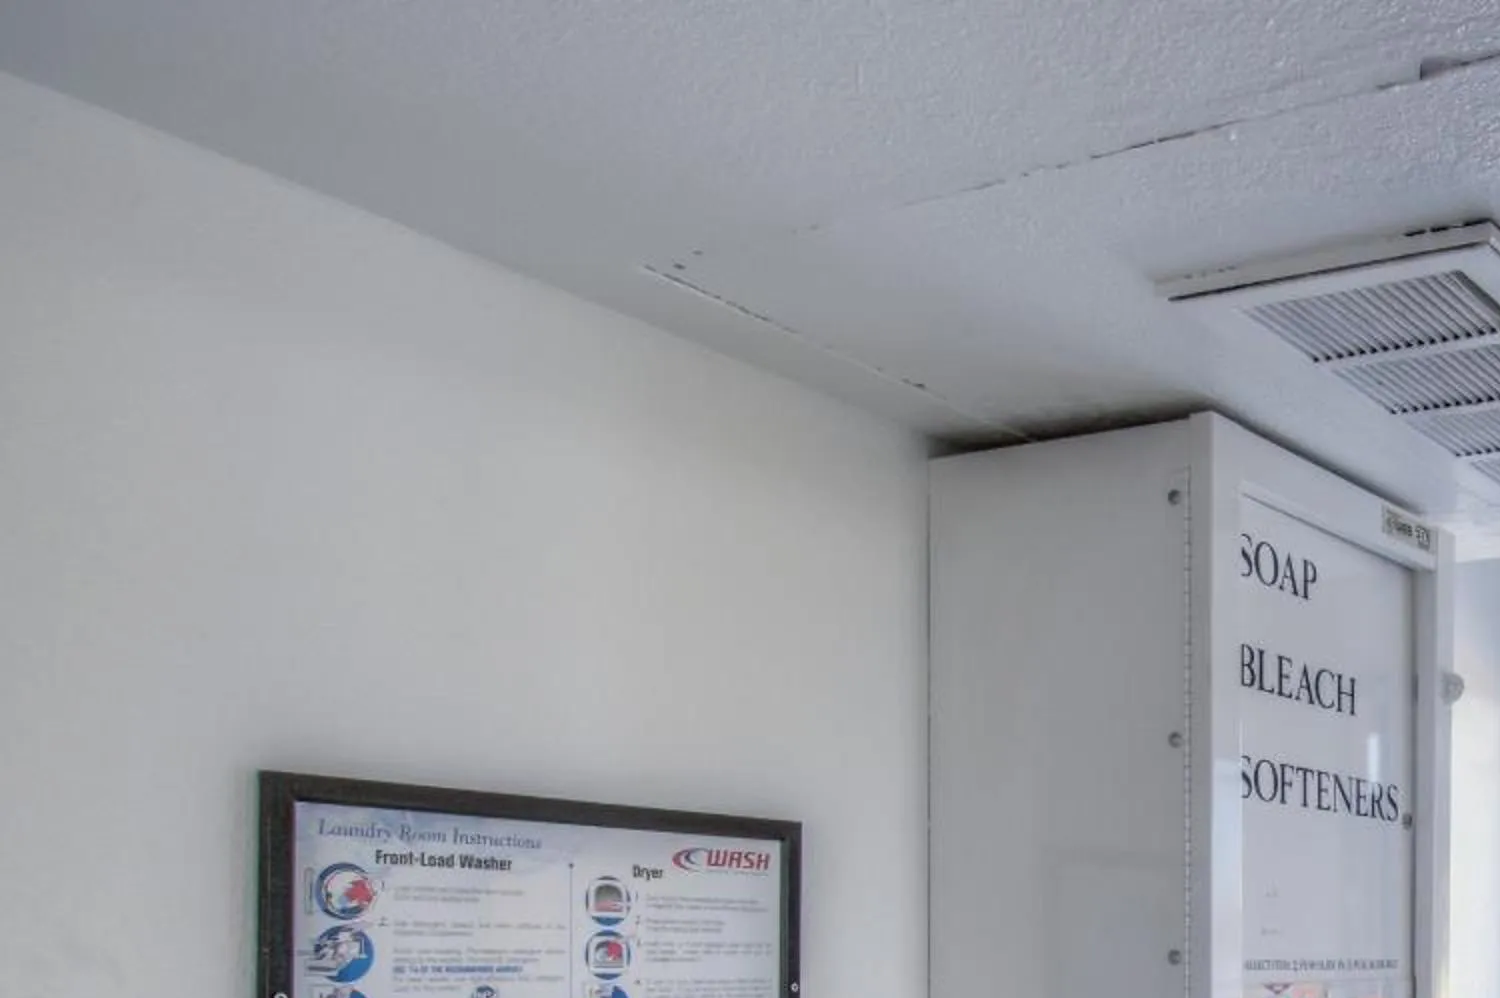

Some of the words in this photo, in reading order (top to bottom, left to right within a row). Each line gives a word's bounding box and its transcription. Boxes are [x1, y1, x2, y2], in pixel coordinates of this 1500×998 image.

[1240, 533, 1317, 600] SOAP
[1240, 643, 1356, 716] BLEACH
[1241, 754, 1399, 823] SOFTENERS
[318, 818, 391, 842] Laundry
[400, 826, 446, 843] Room
[453, 828, 542, 850] Instructions
[375, 849, 455, 869] Front-Load
[459, 853, 512, 871] Washer
[633, 864, 664, 880] Dryer
[706, 849, 771, 870] WASH
